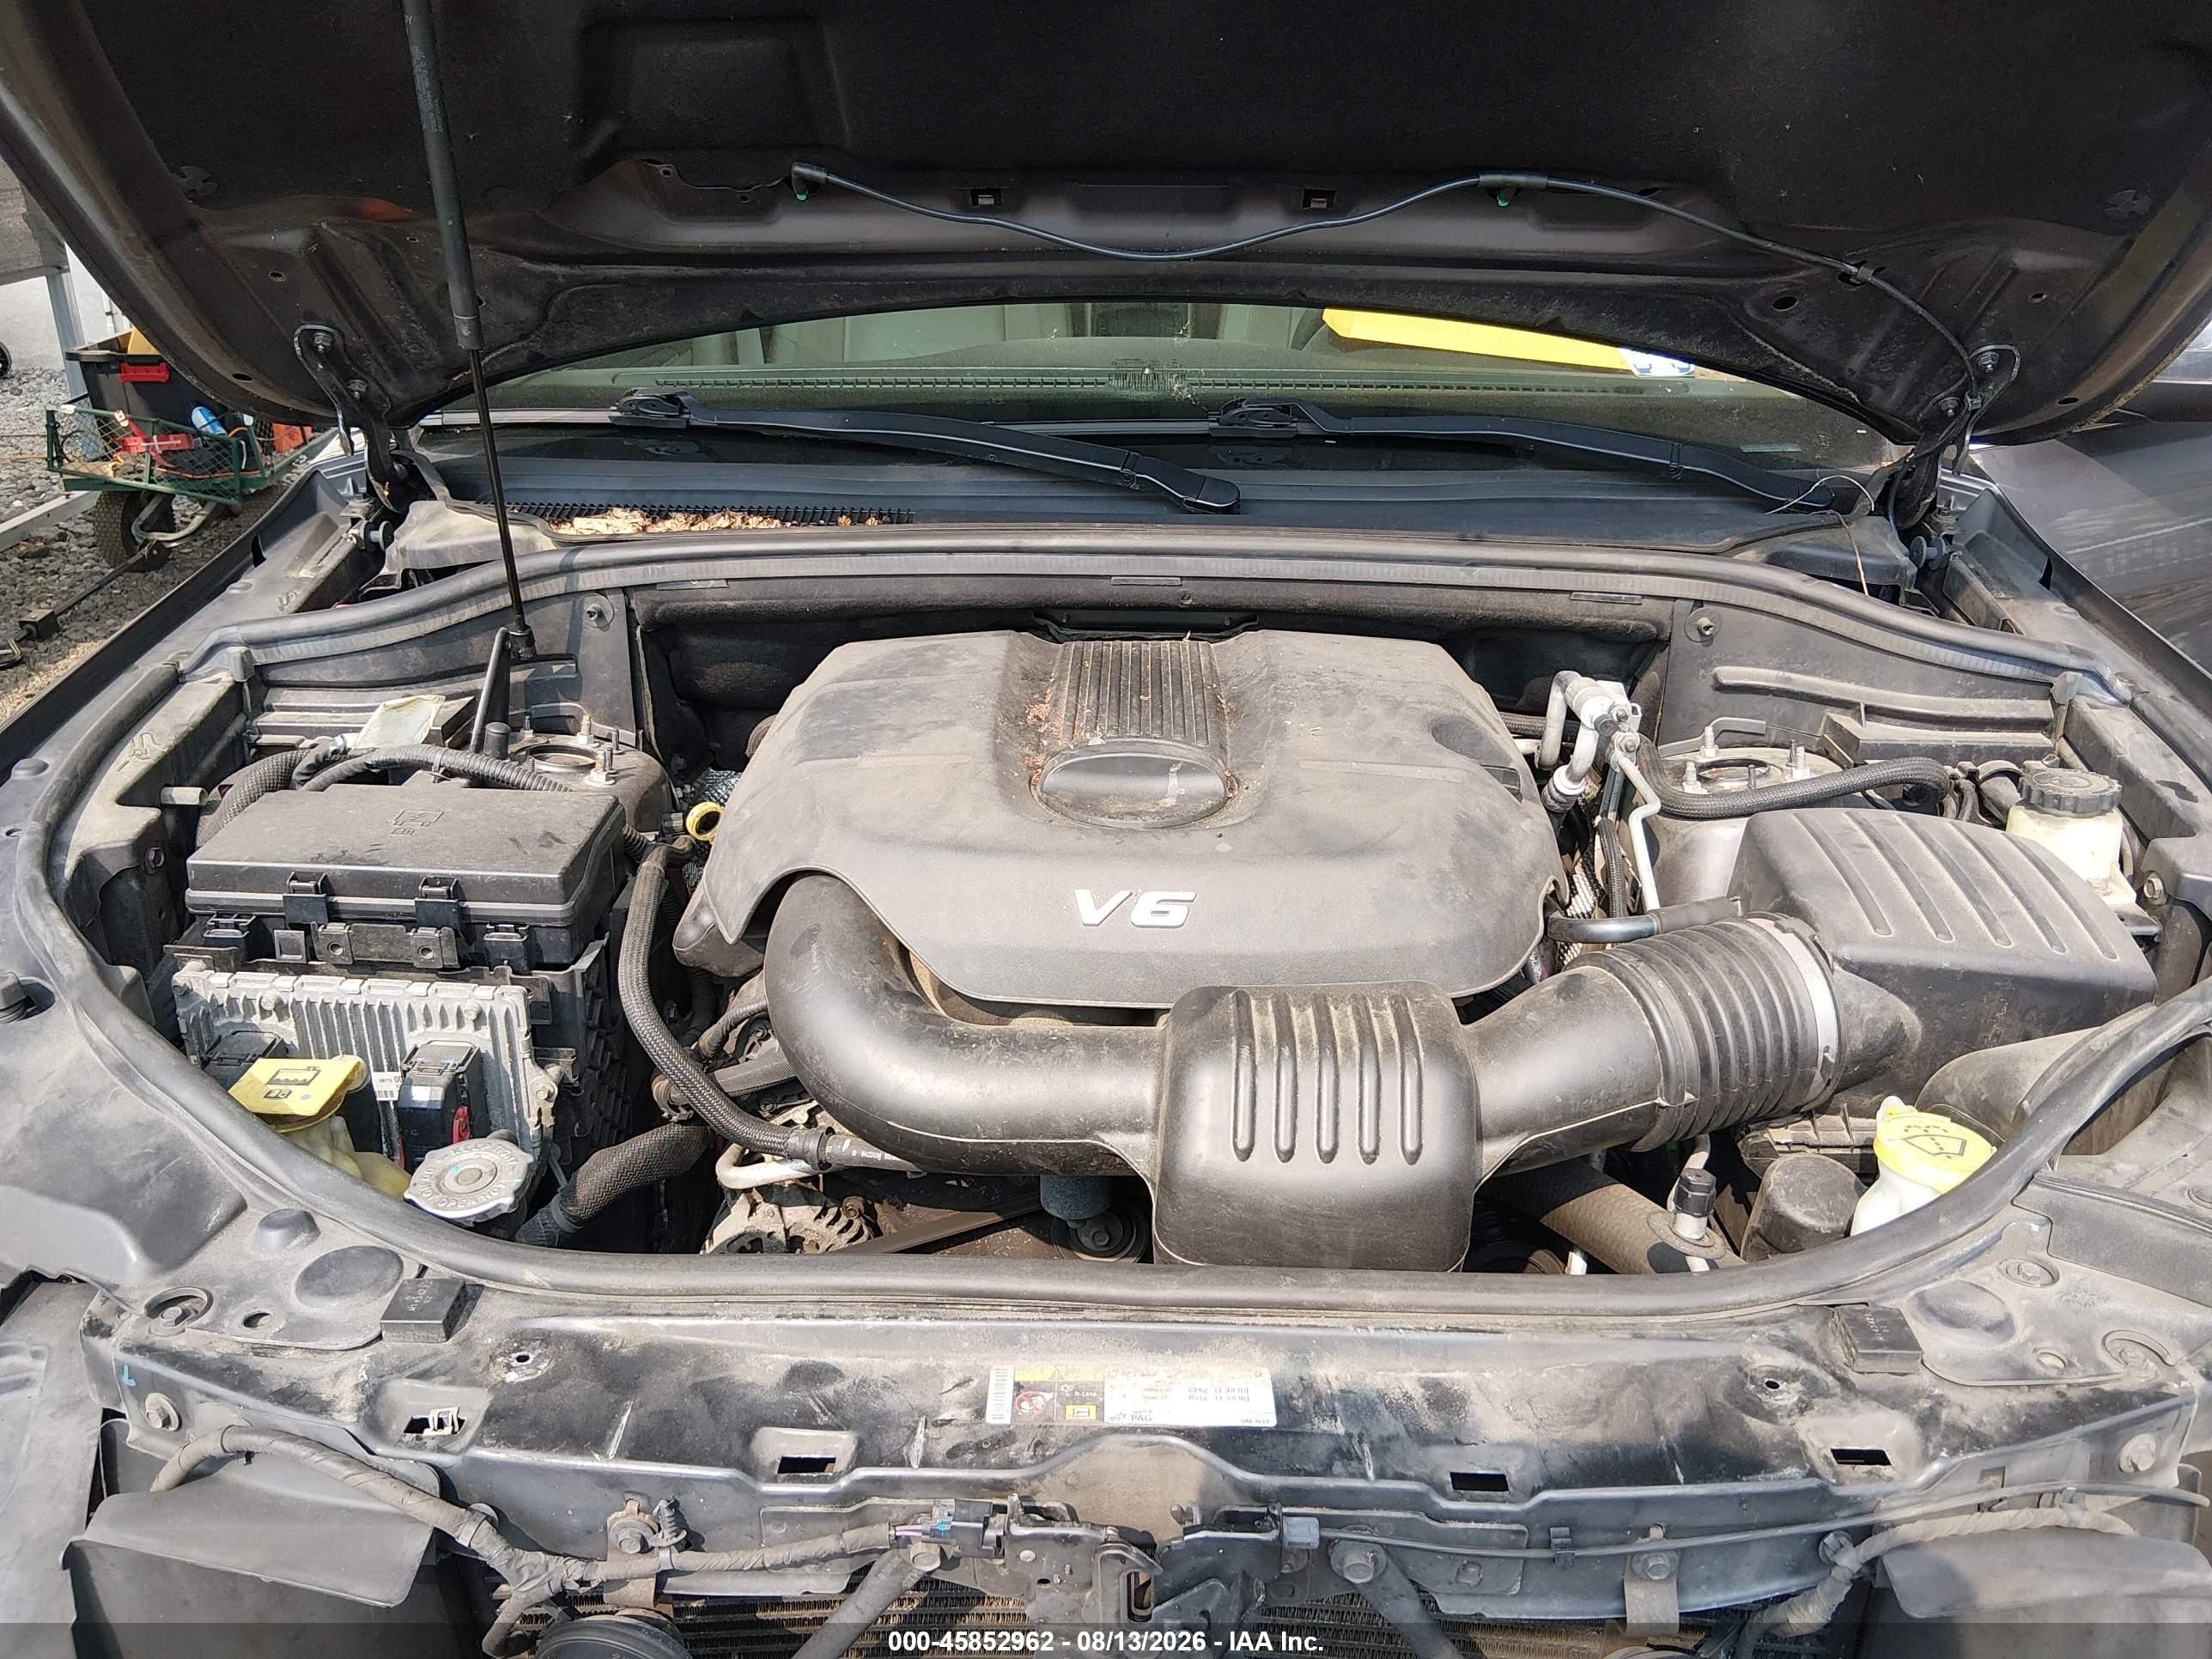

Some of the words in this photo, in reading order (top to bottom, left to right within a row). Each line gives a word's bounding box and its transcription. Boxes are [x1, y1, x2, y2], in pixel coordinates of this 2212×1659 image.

[1073, 889, 1197, 928] V6
[450, 1142, 491, 1155] KEEP
[438, 1197, 477, 1208] OPEN
[480, 1181, 507, 1201] HOT
[123, 1364, 137, 1387] L
